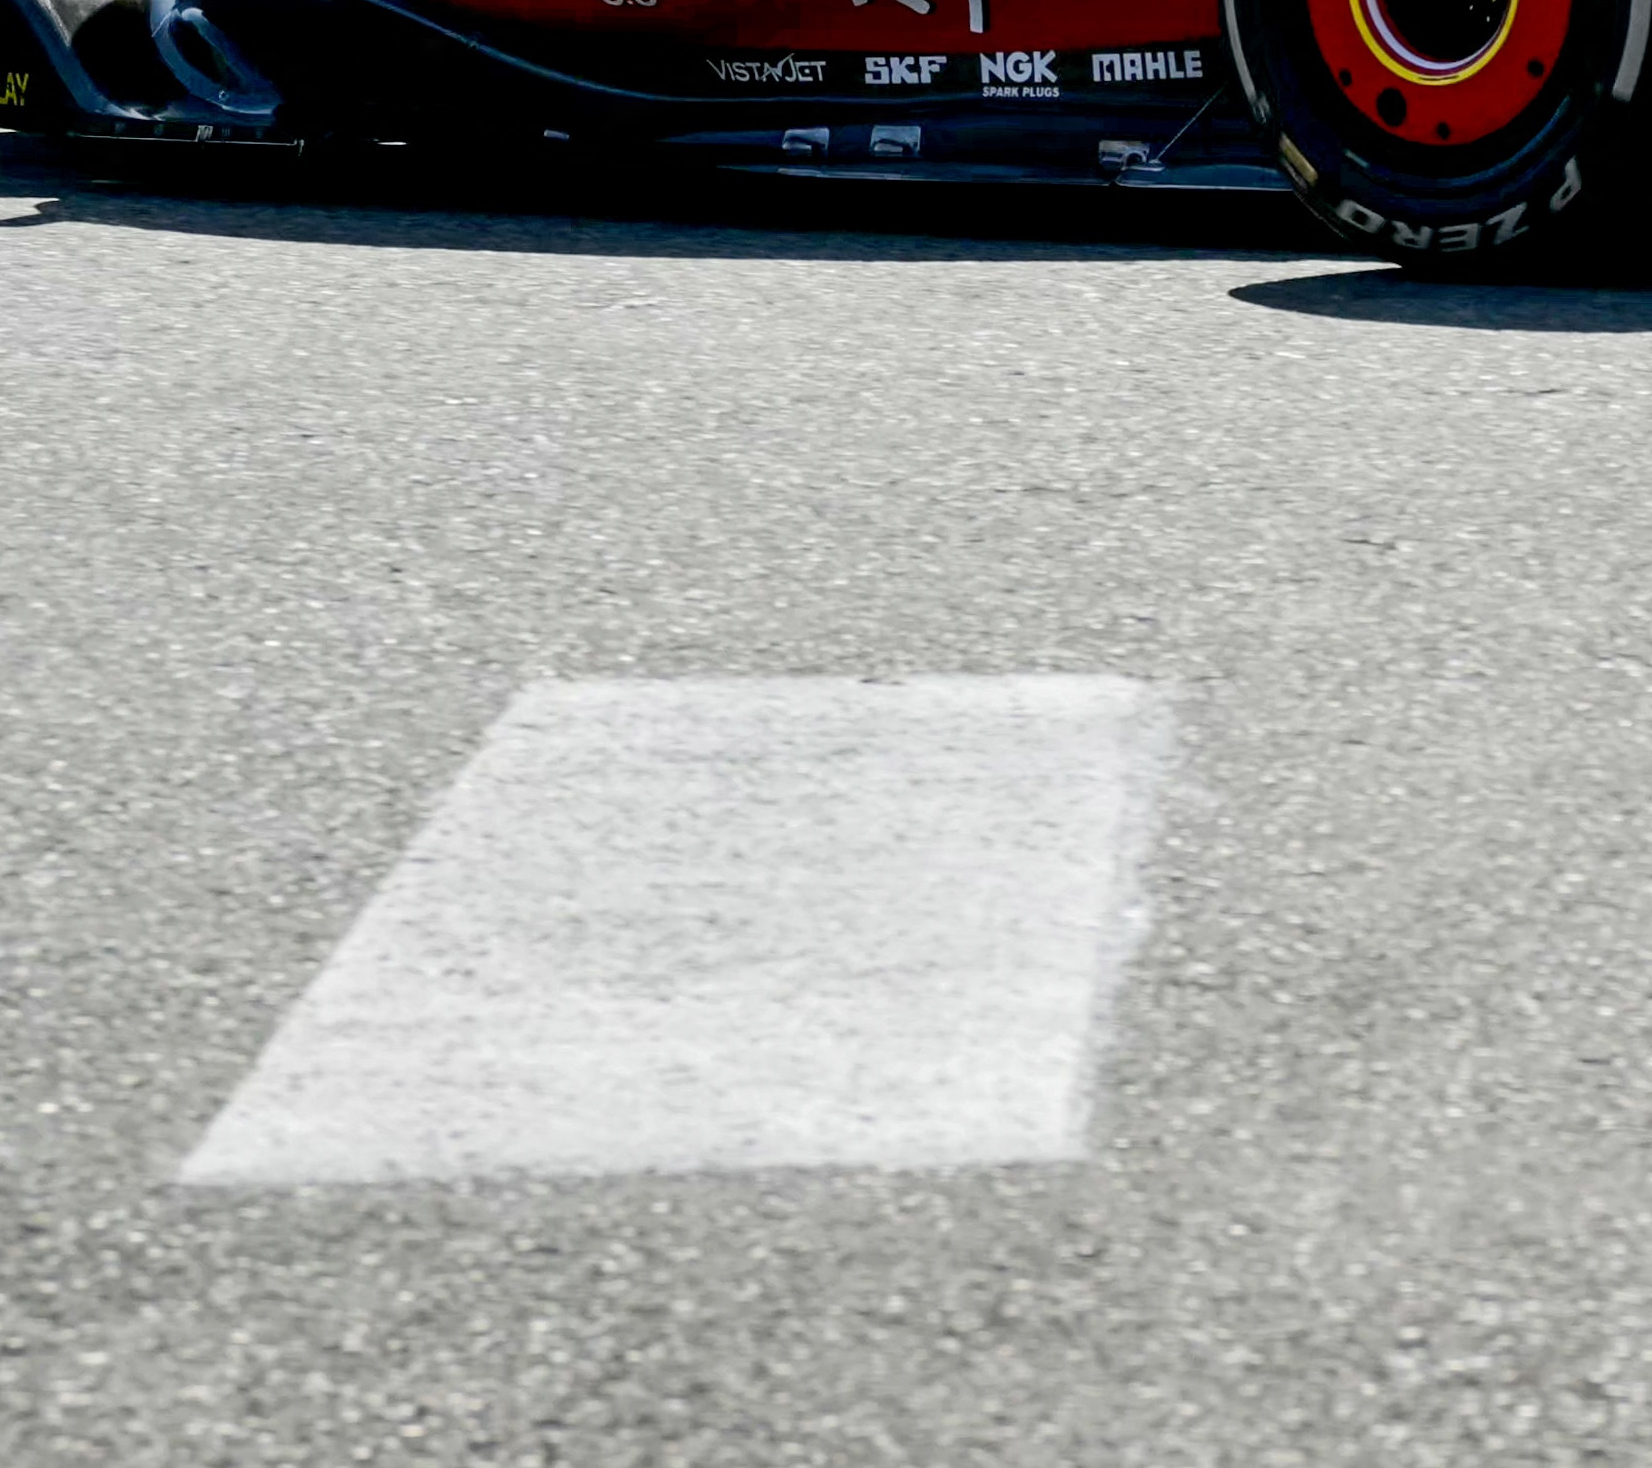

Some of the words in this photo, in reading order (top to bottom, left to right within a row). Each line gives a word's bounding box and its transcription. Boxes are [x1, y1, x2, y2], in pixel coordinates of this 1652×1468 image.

[864, 56, 947, 85] SKF
[980, 50, 1057, 84] NGK
[1091, 50, 1203, 82] MAHLE
[981, 85, 1020, 98] SPARK
[1023, 85, 1061, 98] PLUGS
[1336, 199, 1530, 253] ZERO
